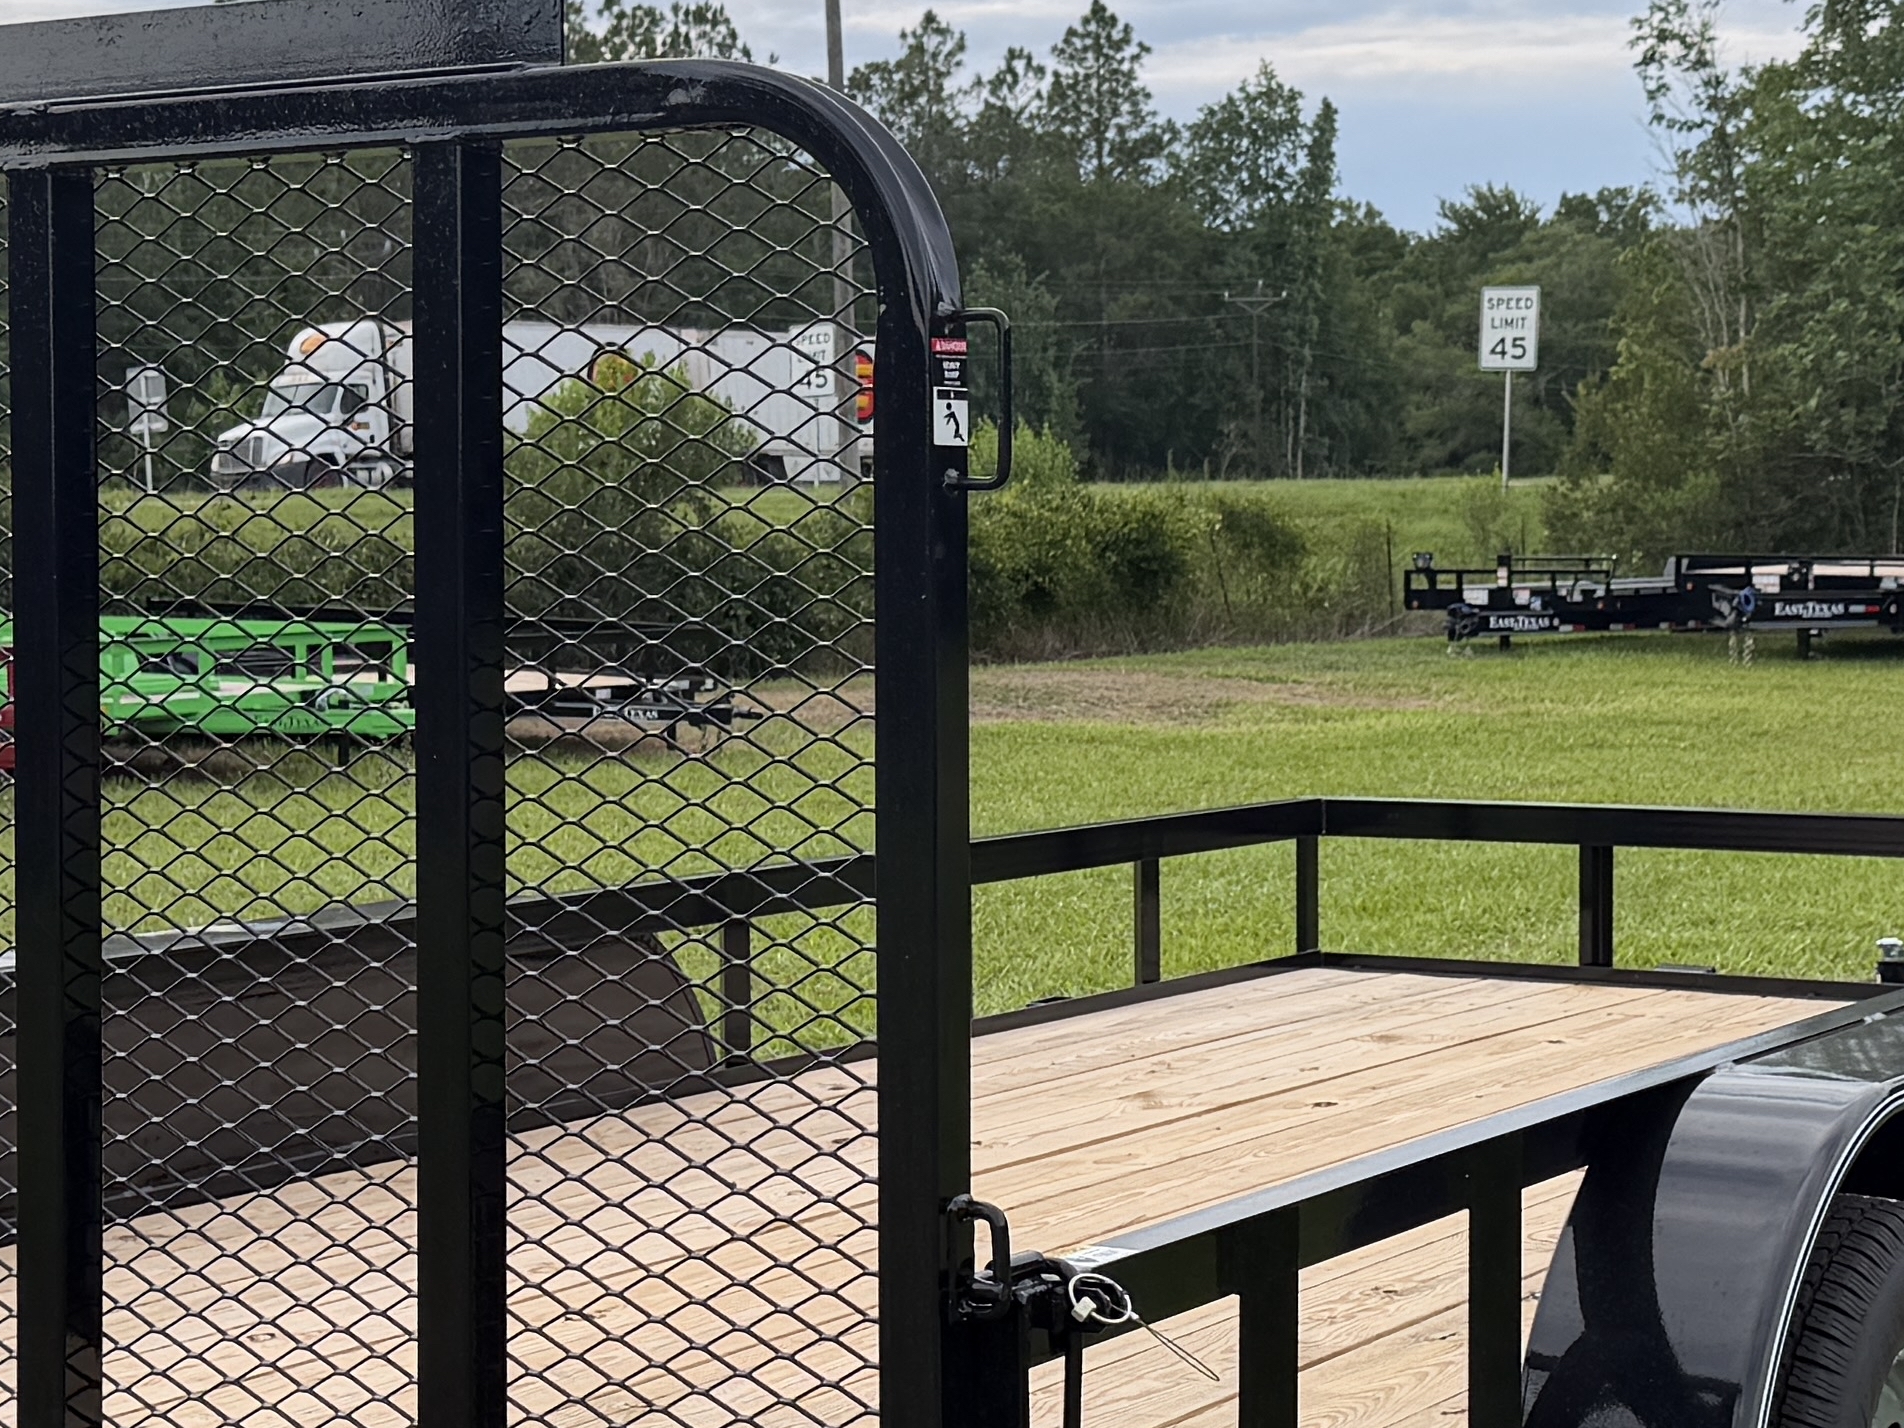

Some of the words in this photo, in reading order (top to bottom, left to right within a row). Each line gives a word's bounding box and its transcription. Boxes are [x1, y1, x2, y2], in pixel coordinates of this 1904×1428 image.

[1487, 297, 1534, 310] SPEED
[1490, 317, 1528, 330] LIMIT
[1489, 336, 1527, 360] 45
